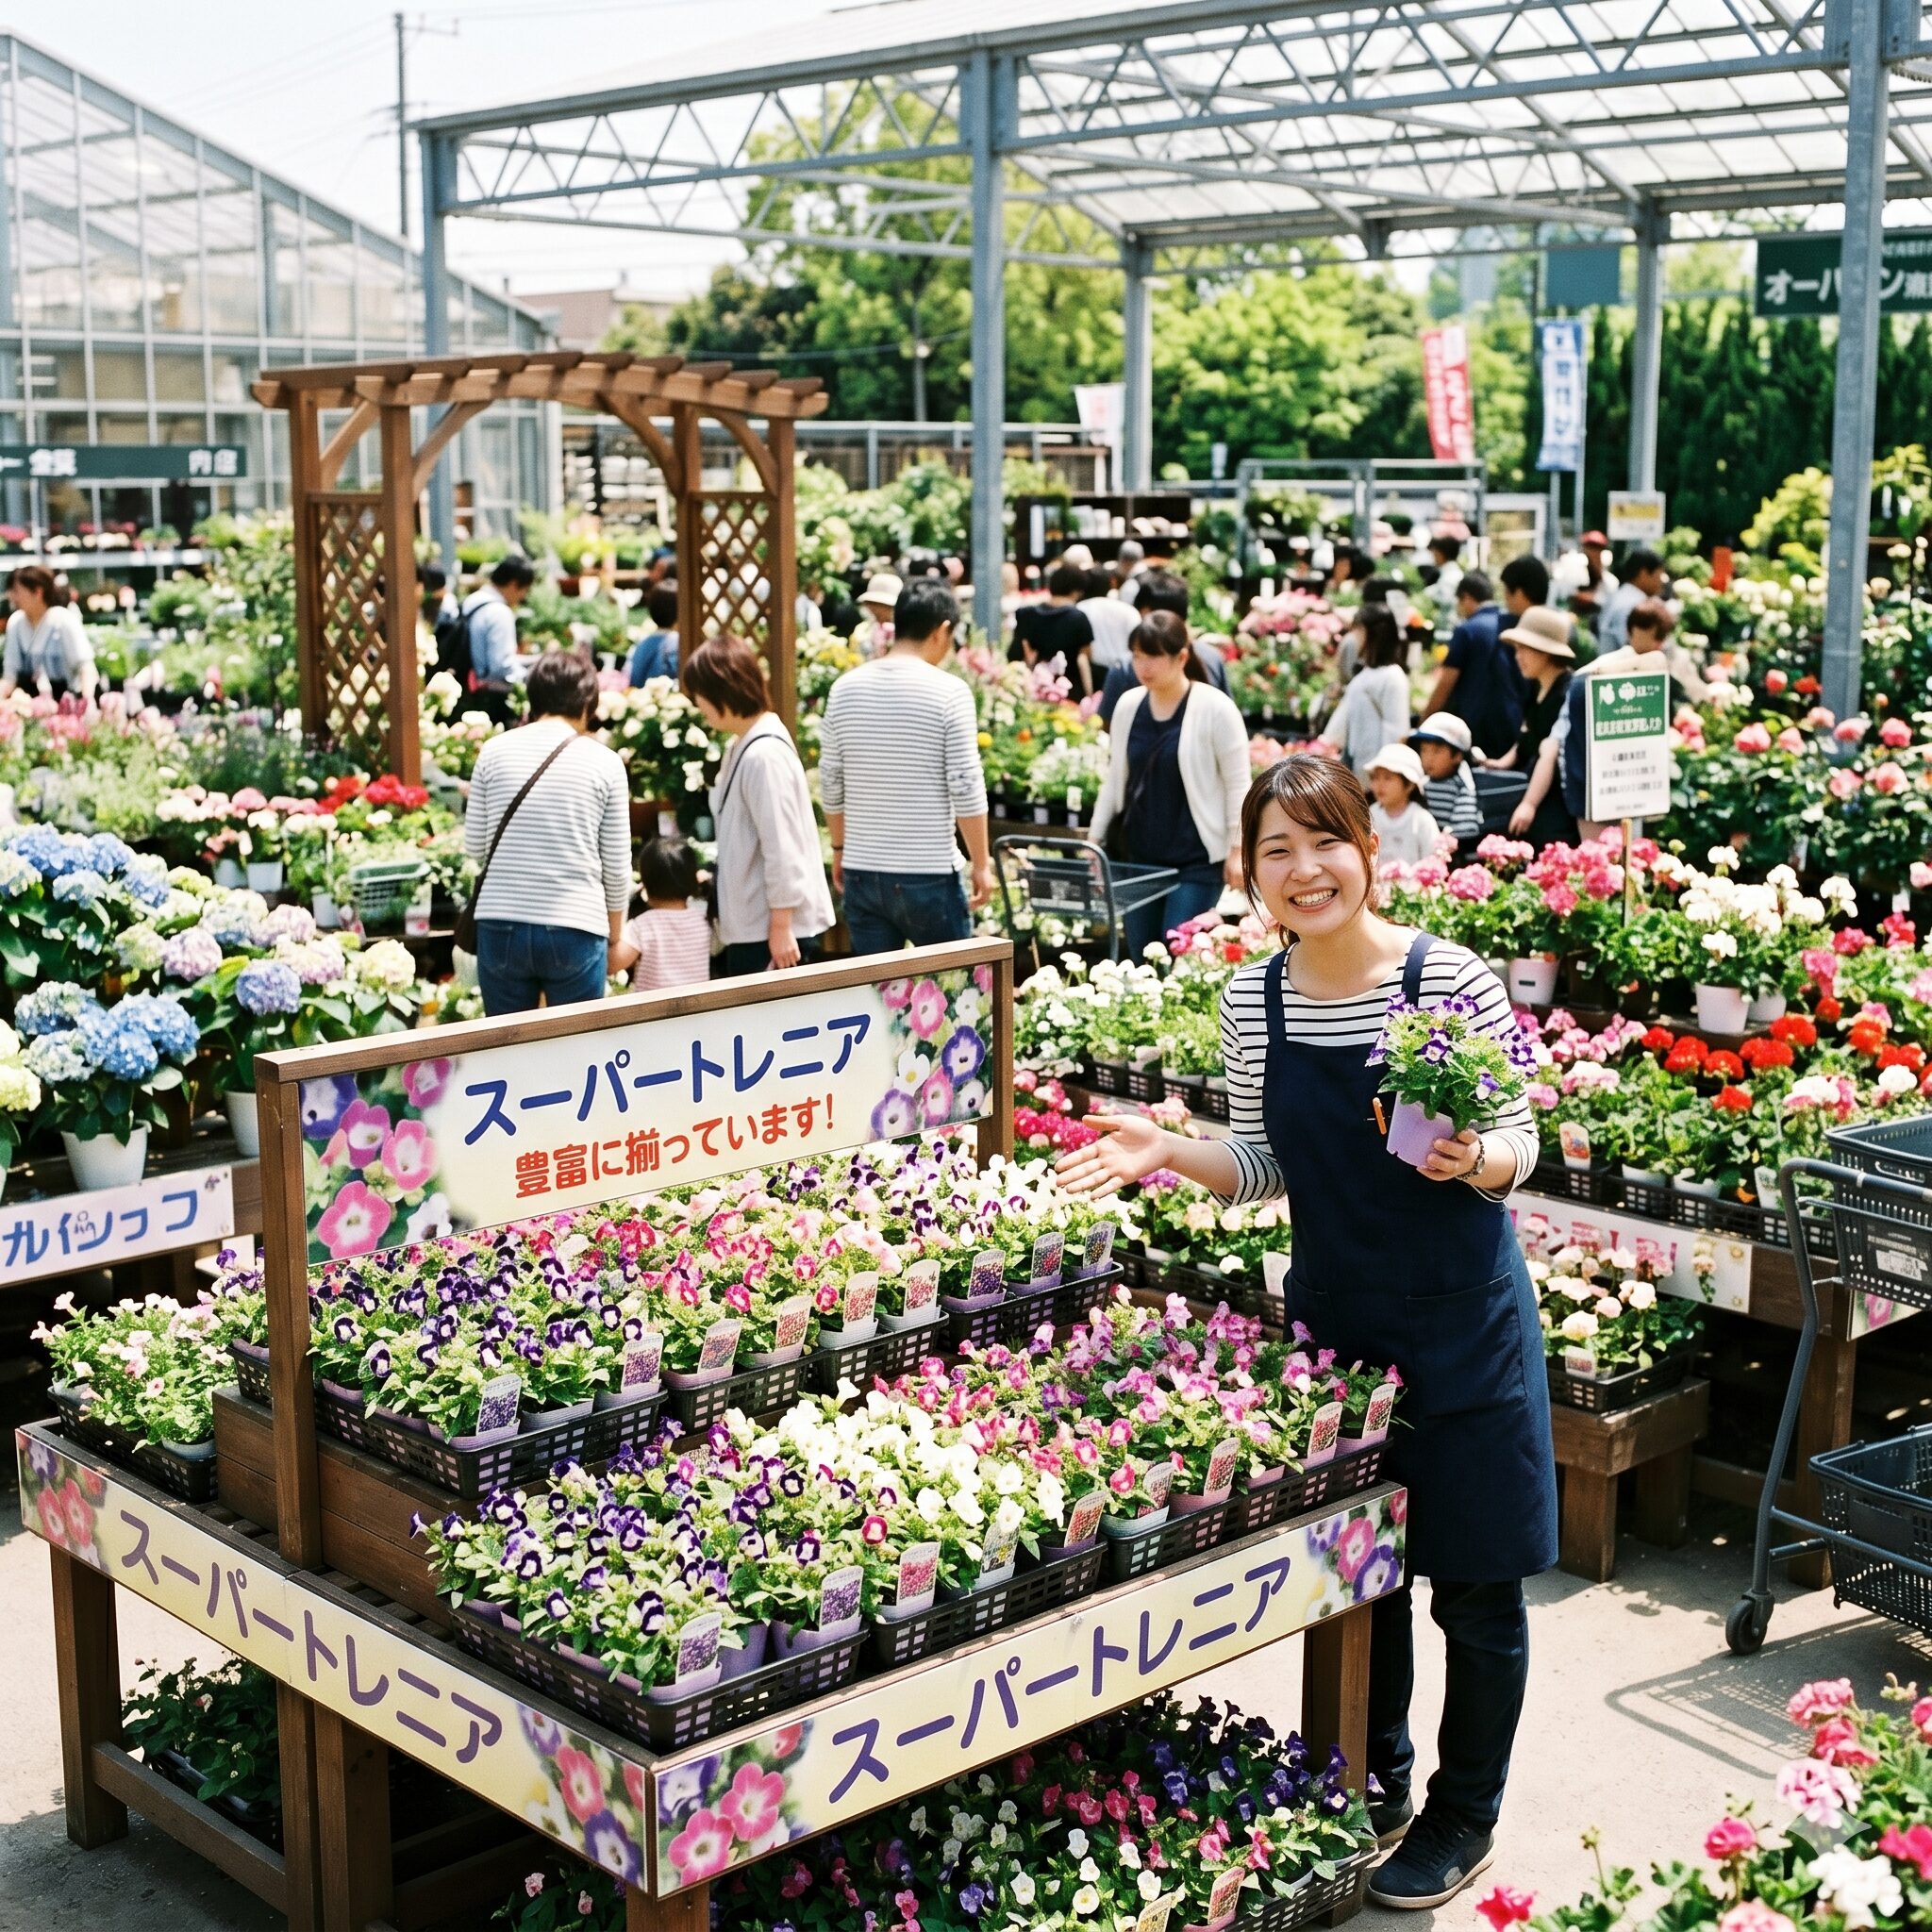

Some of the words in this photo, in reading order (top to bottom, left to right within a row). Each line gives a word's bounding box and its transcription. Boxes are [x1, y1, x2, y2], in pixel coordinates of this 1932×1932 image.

[465, 1013, 872, 1145] スーパートレニア
[120, 1508, 503, 1764] スーパートレニア
[828, 1556, 1291, 1804] スーパートレニア
